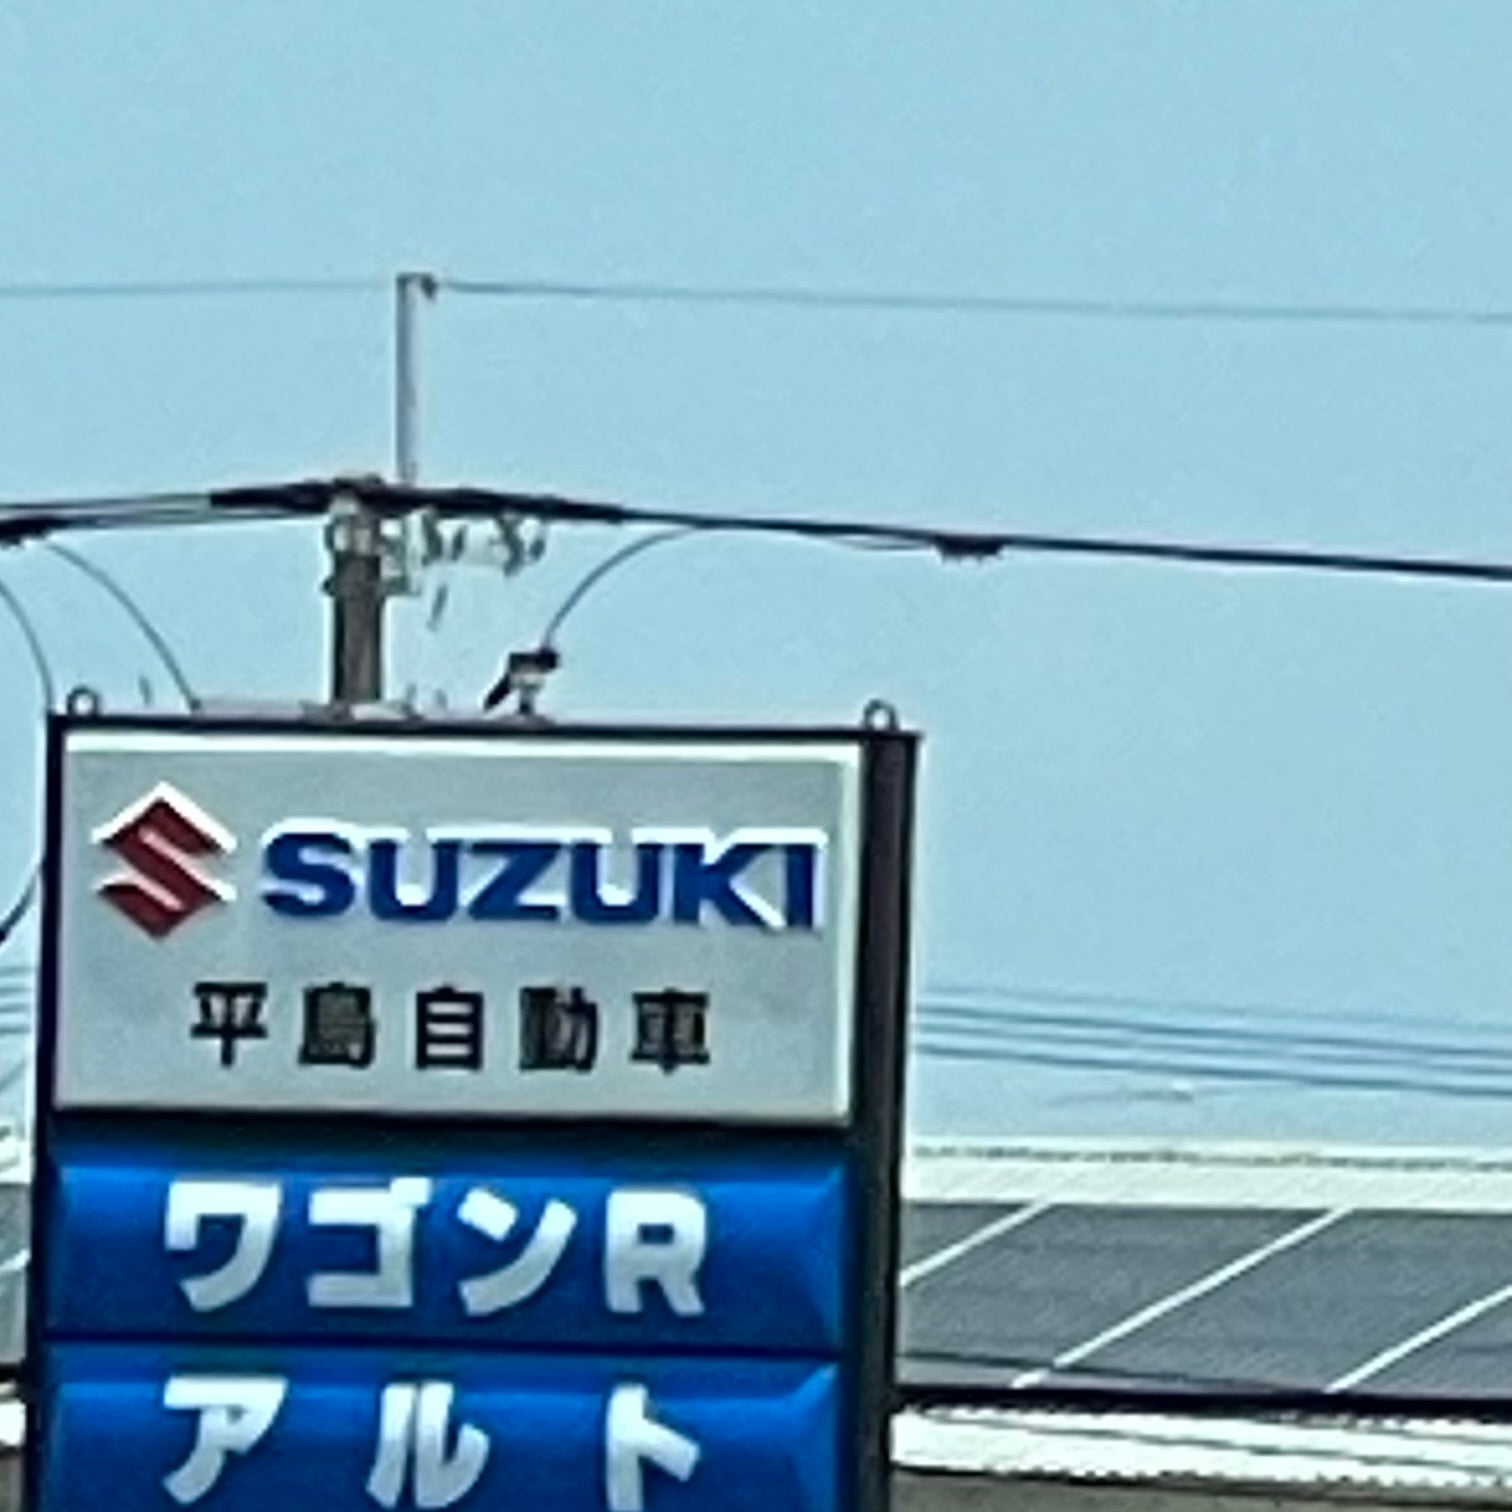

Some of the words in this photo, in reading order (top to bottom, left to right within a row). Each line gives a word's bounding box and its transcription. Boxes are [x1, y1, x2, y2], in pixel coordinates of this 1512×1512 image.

[260, 820, 826, 930] SUZUKI
[190, 980, 712, 1074] 平島自動車
[164, 1176, 708, 1318] ワゴンR
